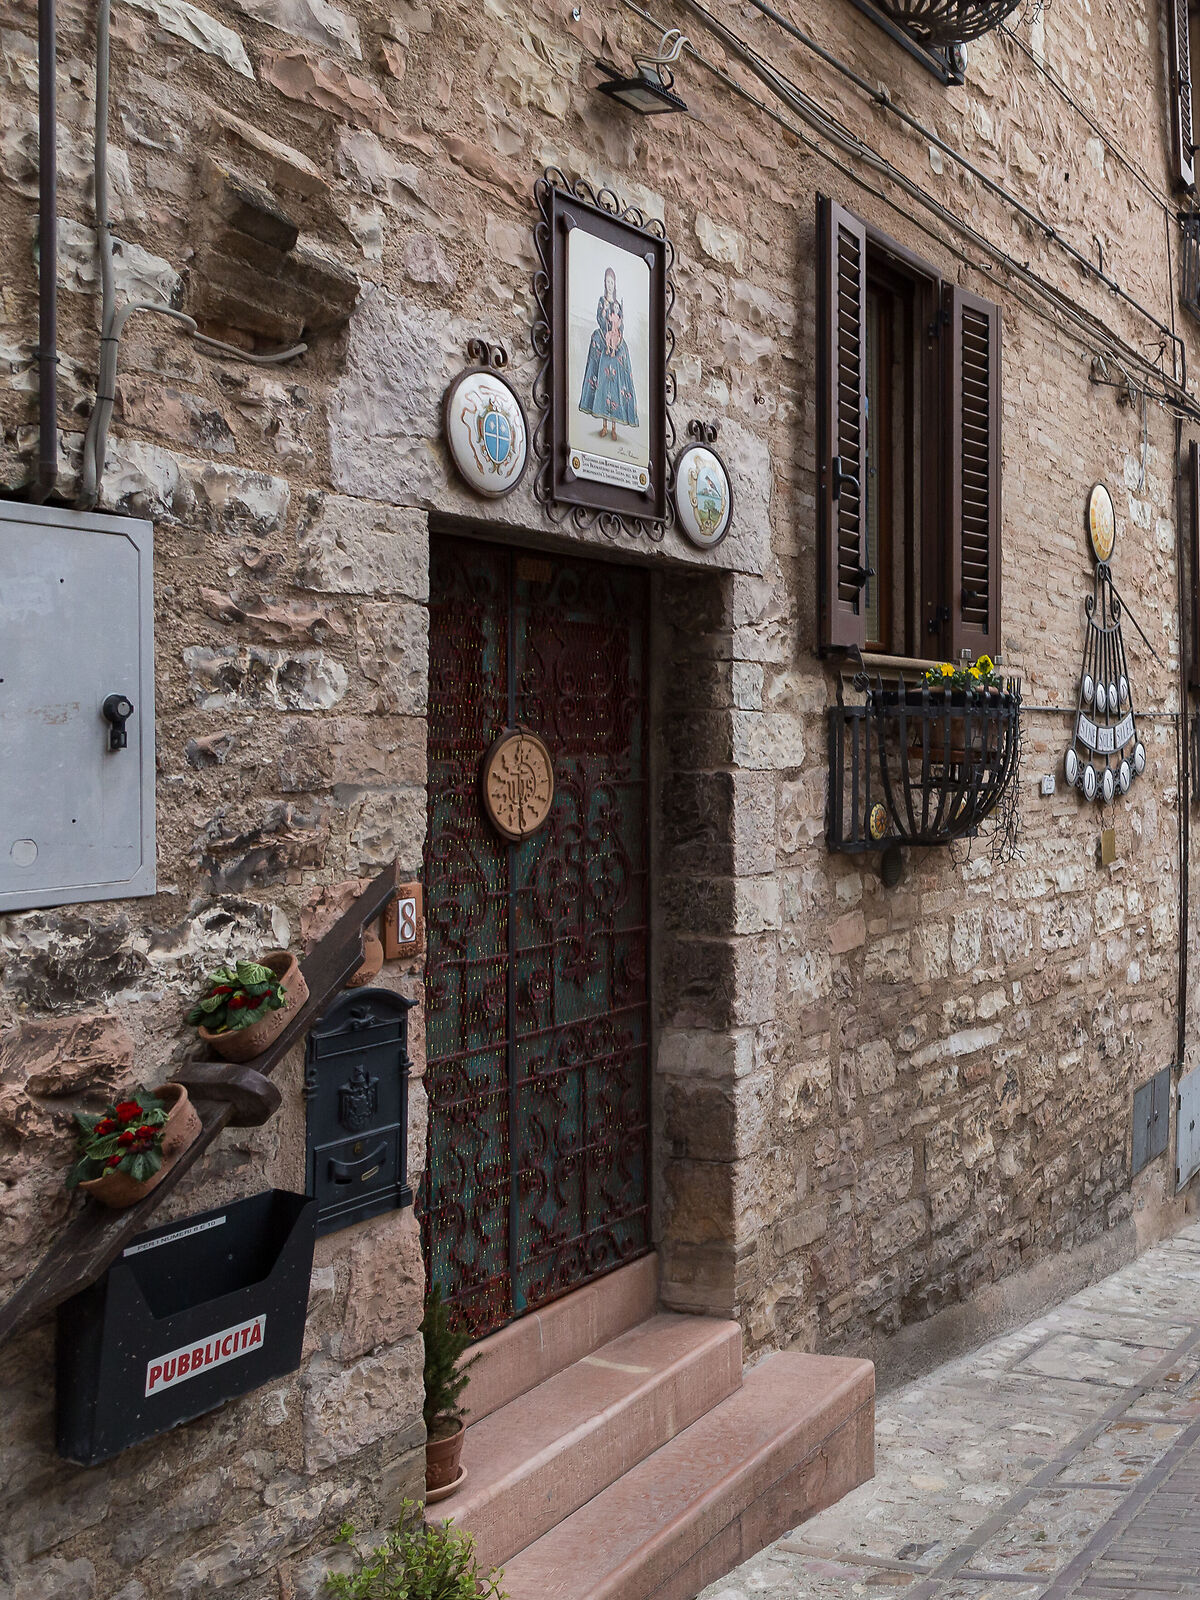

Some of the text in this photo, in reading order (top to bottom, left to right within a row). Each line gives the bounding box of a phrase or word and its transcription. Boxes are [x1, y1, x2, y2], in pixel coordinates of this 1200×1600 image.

[401, 902, 415, 940] 8
[137, 1241, 155, 1251] PER
[161, 1229, 192, 1242] NUMERI
[149, 1319, 261, 1390] PUBBLICITÀ
